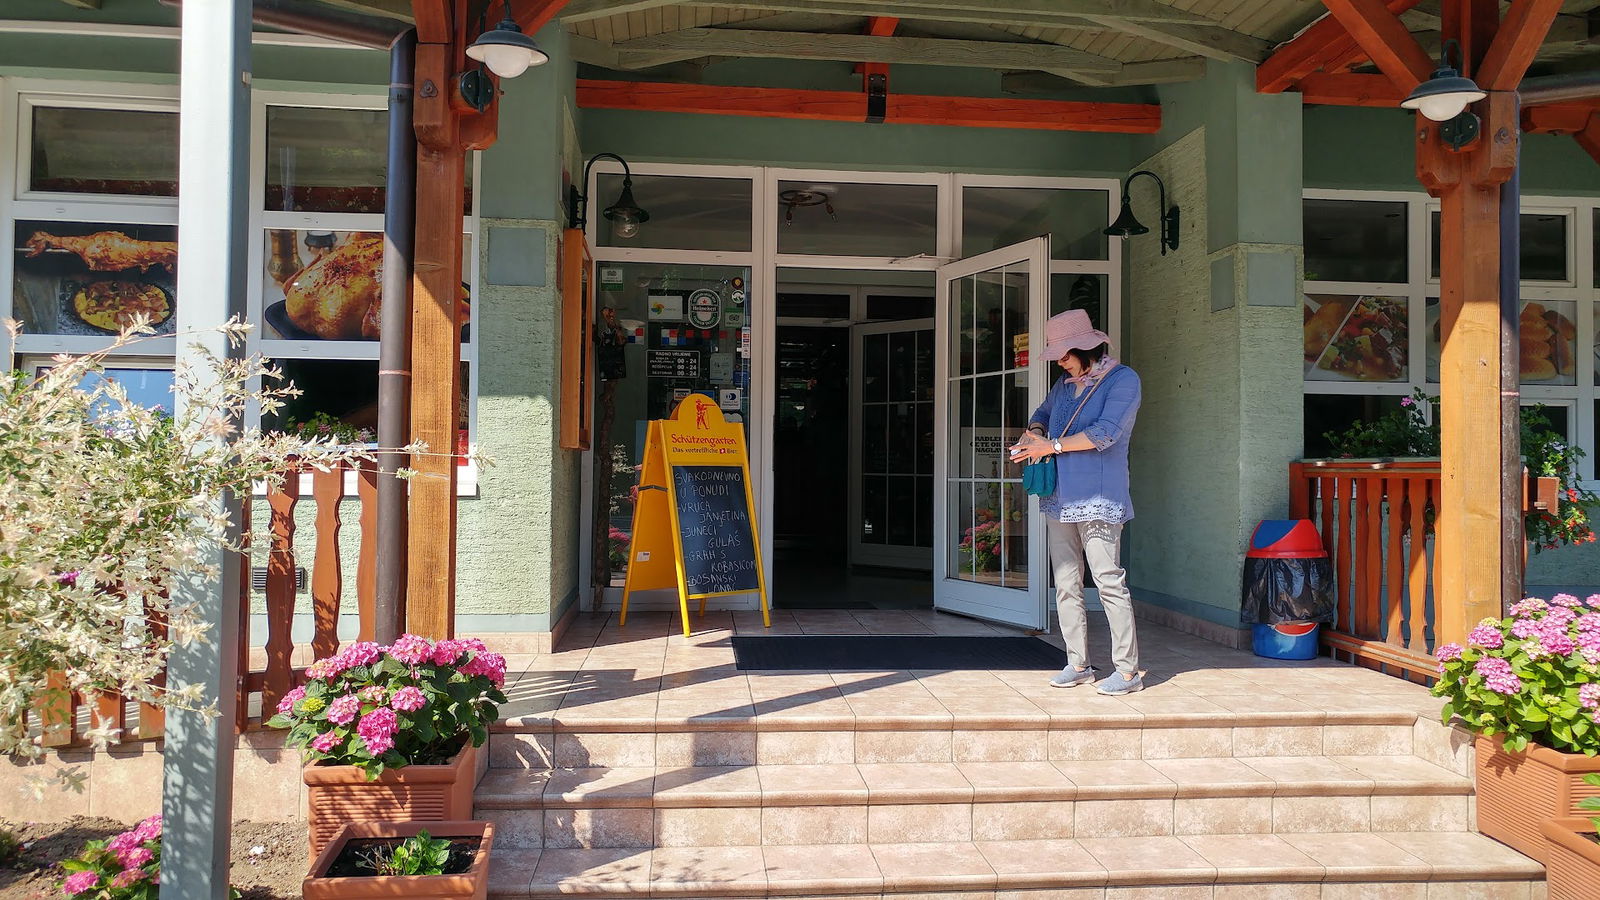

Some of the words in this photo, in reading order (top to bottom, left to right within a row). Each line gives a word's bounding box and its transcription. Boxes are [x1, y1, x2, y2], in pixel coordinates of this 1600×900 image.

[671, 433, 737, 447] Schützengarten
[672, 446, 684, 454] Das
[675, 471, 741, 485] SVAKODNEVNO
[680, 487, 687, 499] U
[691, 484, 729, 497] PONUDI
[720, 550, 727, 560] S
